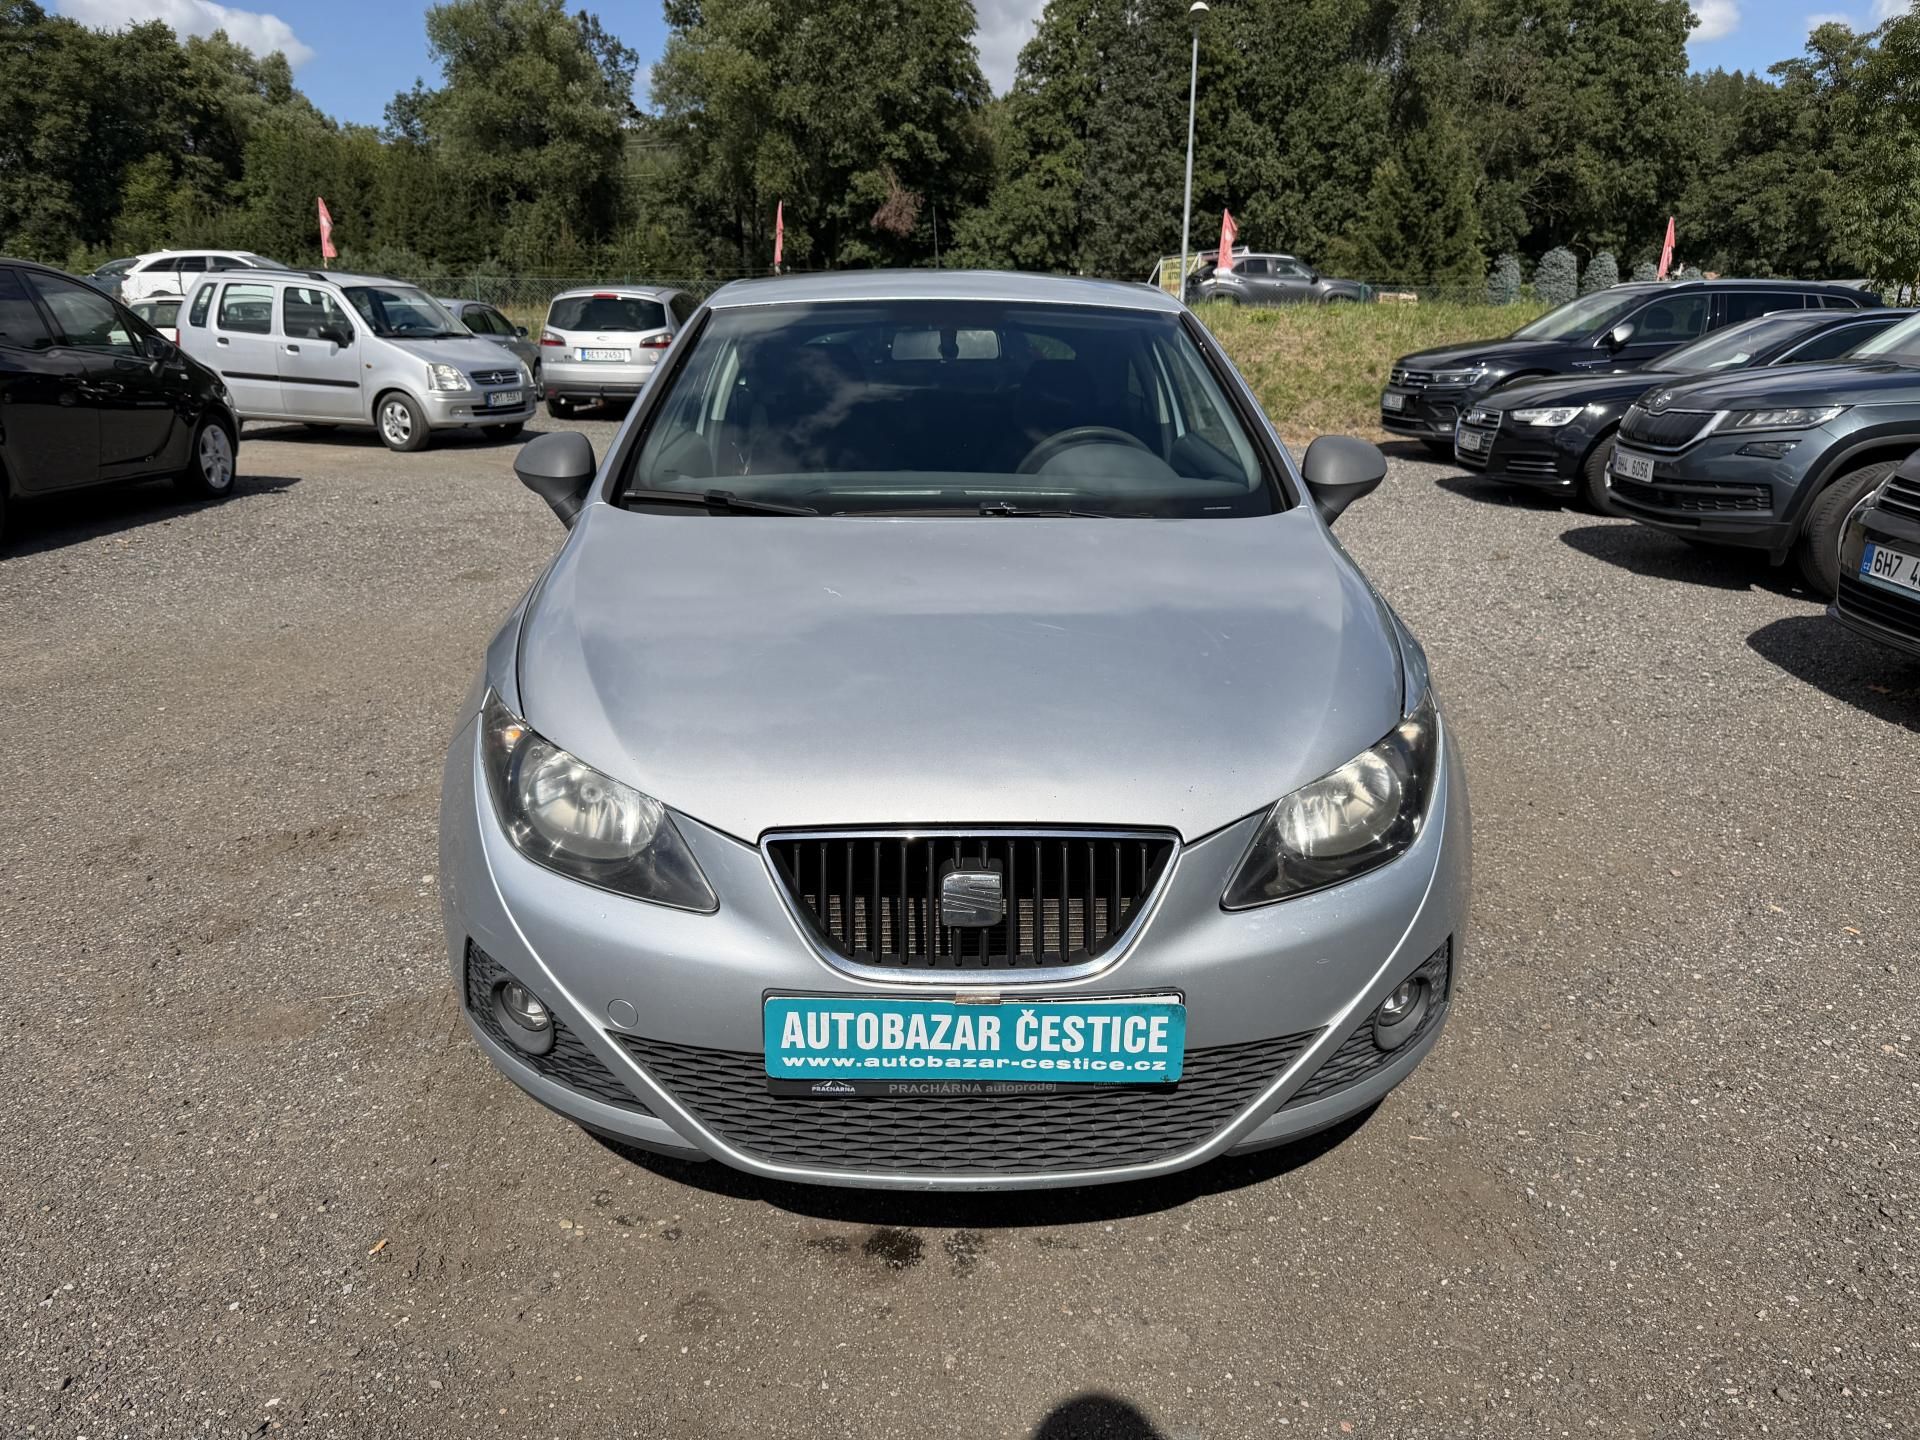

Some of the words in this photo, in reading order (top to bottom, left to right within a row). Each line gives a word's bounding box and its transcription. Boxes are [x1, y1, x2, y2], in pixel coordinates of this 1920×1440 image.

[1874, 550, 1903, 578] 6H7
[1909, 561, 1920, 587] 4
[781, 1011, 1001, 1051] AUTOBAZAR
[1016, 1009, 1169, 1053] ČESTICE
[782, 1056, 1167, 1071] www.autobazar-cestice.cz
[888, 1081, 983, 1094] PRACHÁRNA
[985, 1082, 1057, 1093] autoprodej
